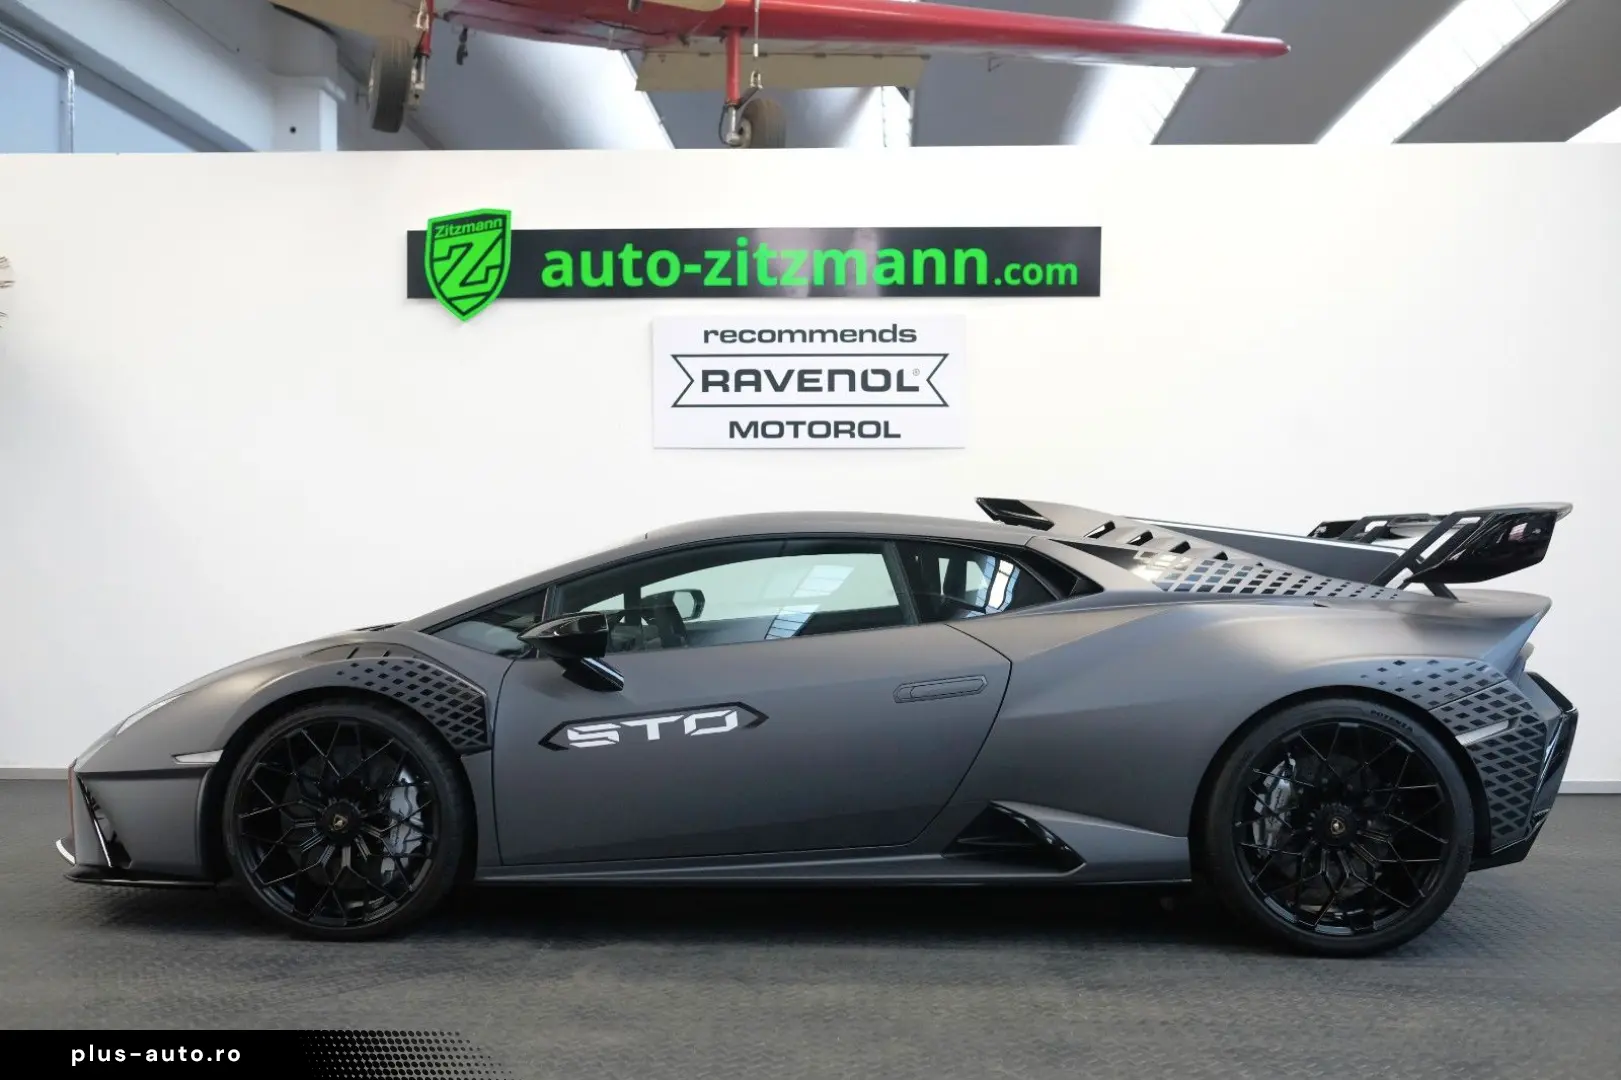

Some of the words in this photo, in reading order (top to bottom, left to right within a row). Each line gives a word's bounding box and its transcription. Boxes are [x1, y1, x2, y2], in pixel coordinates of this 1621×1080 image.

[434, 218, 502, 238] Zitzmann
[541, 236, 1079, 288] auto-zitzmann.com
[703, 323, 917, 344] recommends
[729, 420, 902, 439] MOTOROL
[566, 709, 739, 748] STO
